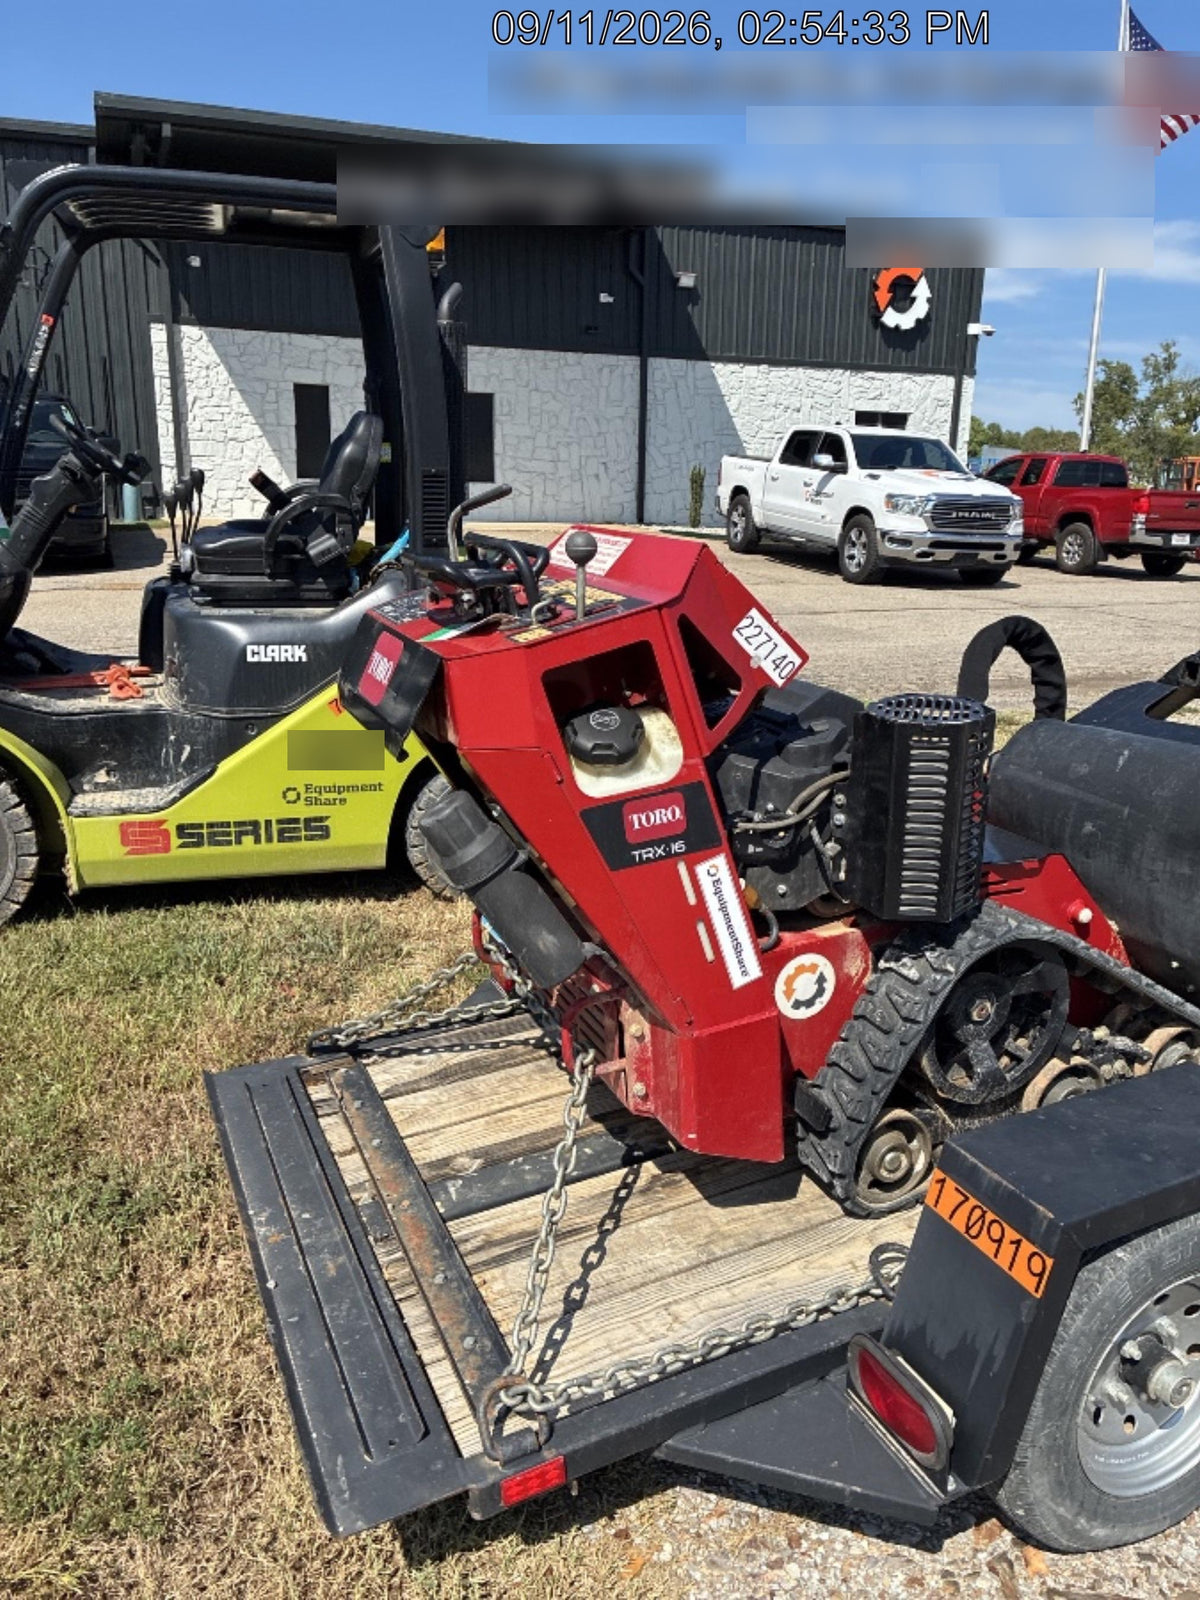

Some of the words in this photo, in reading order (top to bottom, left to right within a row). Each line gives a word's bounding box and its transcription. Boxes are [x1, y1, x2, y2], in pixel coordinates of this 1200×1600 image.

[246, 644, 308, 663] CLARK
[735, 614, 796, 680] 227140
[304, 782, 385, 797] Equipment
[304, 796, 348, 807] Share
[175, 815, 332, 849] SERIES
[629, 804, 682, 830] TORO
[711, 877, 750, 978] EquipmentShare
[933, 1176, 1047, 1294] 170919
